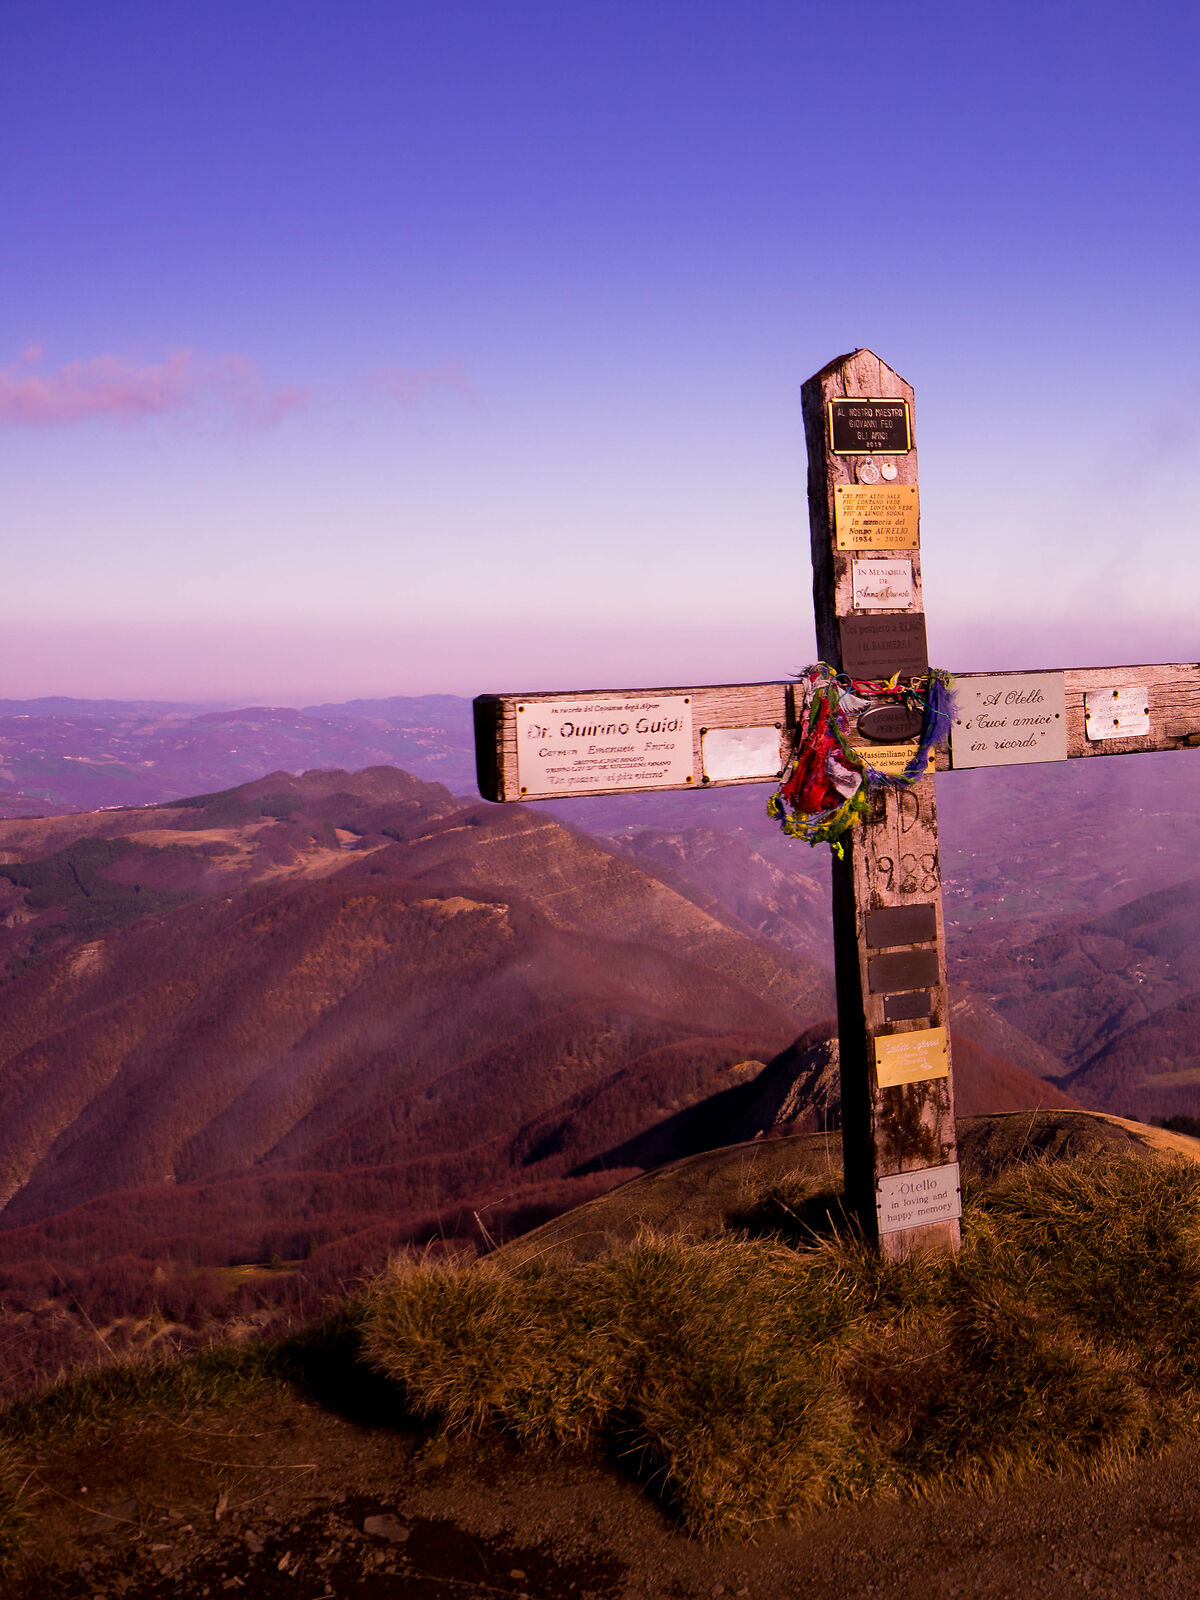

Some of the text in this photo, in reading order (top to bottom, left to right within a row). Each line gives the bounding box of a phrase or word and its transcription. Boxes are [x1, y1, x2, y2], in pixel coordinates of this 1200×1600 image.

[837, 408, 903, 417] AL NOSTRO MAESTRO
[849, 420, 878, 428] GIOVANNI
[857, 431, 888, 440] GLI AMICI
[1004, 689, 1044, 705] Otello
[976, 714, 1007, 728] Tuoi
[1013, 714, 1052, 726] amici
[527, 724, 552, 739] Dr.
[560, 722, 629, 738] Quirino
[971, 741, 987, 751] in
[860, 750, 906, 758] Massimiliano
[900, 1179, 937, 1194] Otello
[903, 1196, 929, 1206] loving
[933, 1191, 948, 1200] and
[888, 1203, 952, 1222] happy memory
